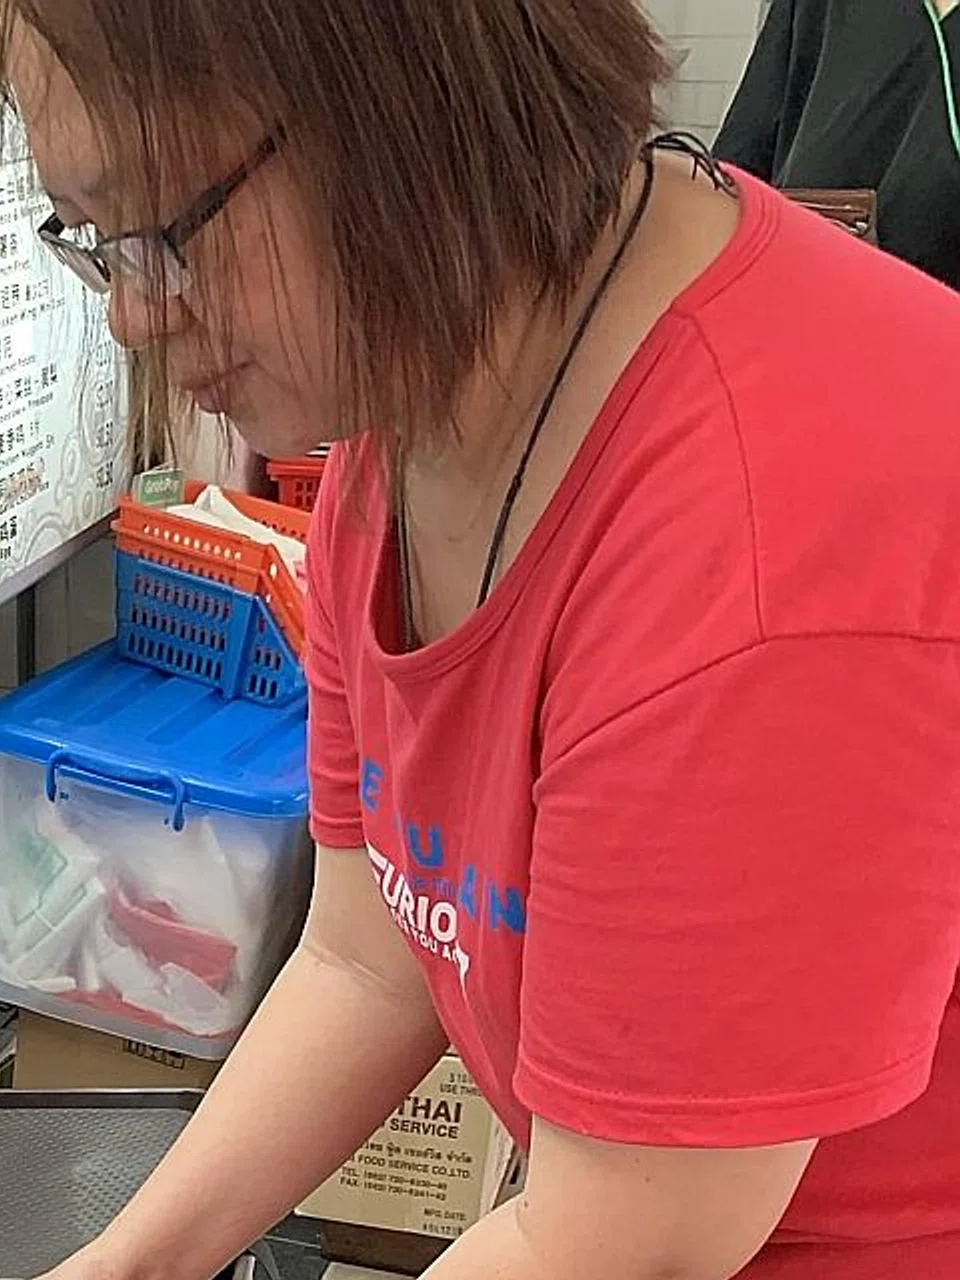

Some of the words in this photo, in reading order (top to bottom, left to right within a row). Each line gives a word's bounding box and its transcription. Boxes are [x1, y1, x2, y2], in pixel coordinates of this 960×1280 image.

[390, 1118, 458, 1139] SERVICE
[358, 1154, 385, 1167] FOOD
[388, 1158, 429, 1173] SERVICE
